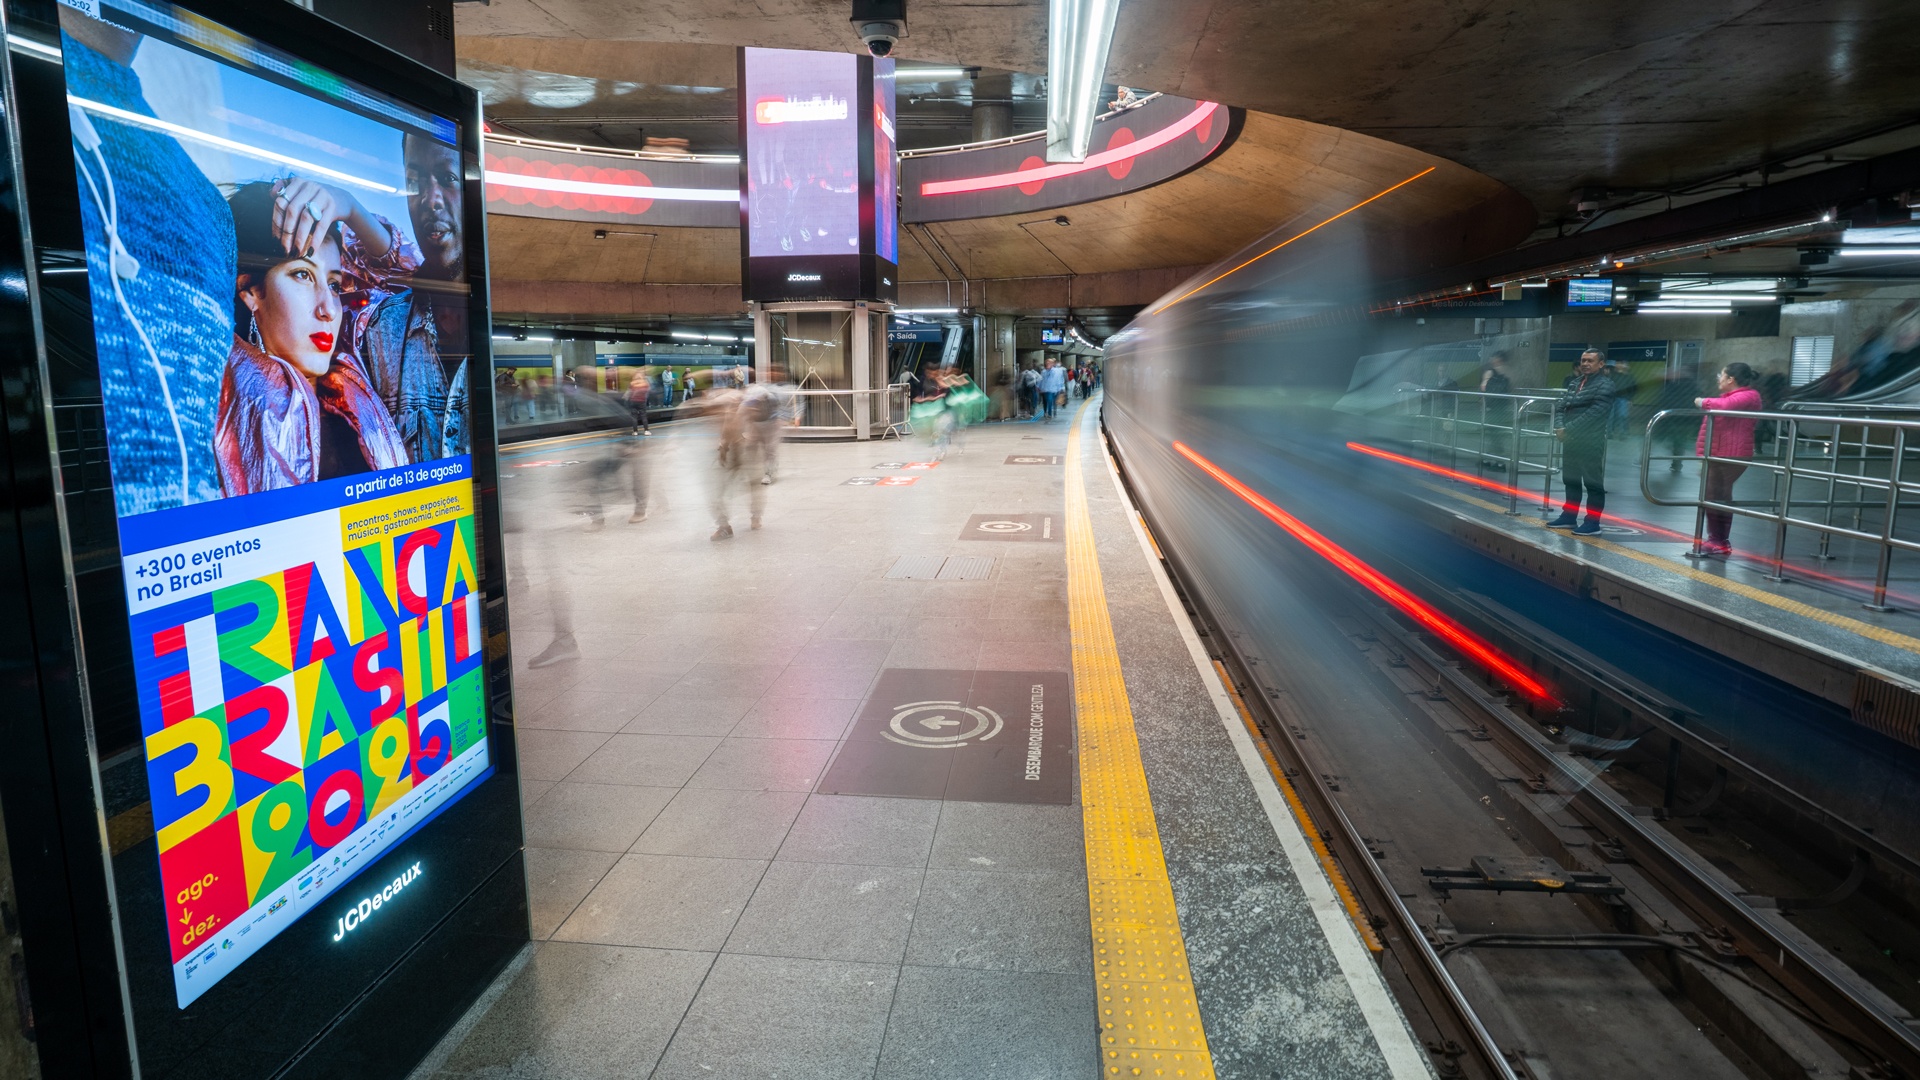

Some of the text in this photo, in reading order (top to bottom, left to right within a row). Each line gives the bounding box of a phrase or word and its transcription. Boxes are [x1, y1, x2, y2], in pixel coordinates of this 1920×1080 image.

[787, 274, 822, 282] JCDecaux
[896, 332, 917, 340] Saída
[1645, 349, 1654, 357] Sé
[345, 463, 463, 499] a partir de 13 de agosto
[347, 495, 460, 531] encontros, shows, exposições,
[348, 527, 382, 542] música,
[384, 512, 434, 534] gastronomia,
[135, 538, 261, 578] +300 eventos
[137, 563, 223, 602] no Brasil
[1025, 684, 1043, 780] DESEMBARQUE COM GENTILEZA
[177, 873, 219, 904] ago.
[333, 861, 422, 941] JCDecaux
[182, 914, 221, 945] dez.
